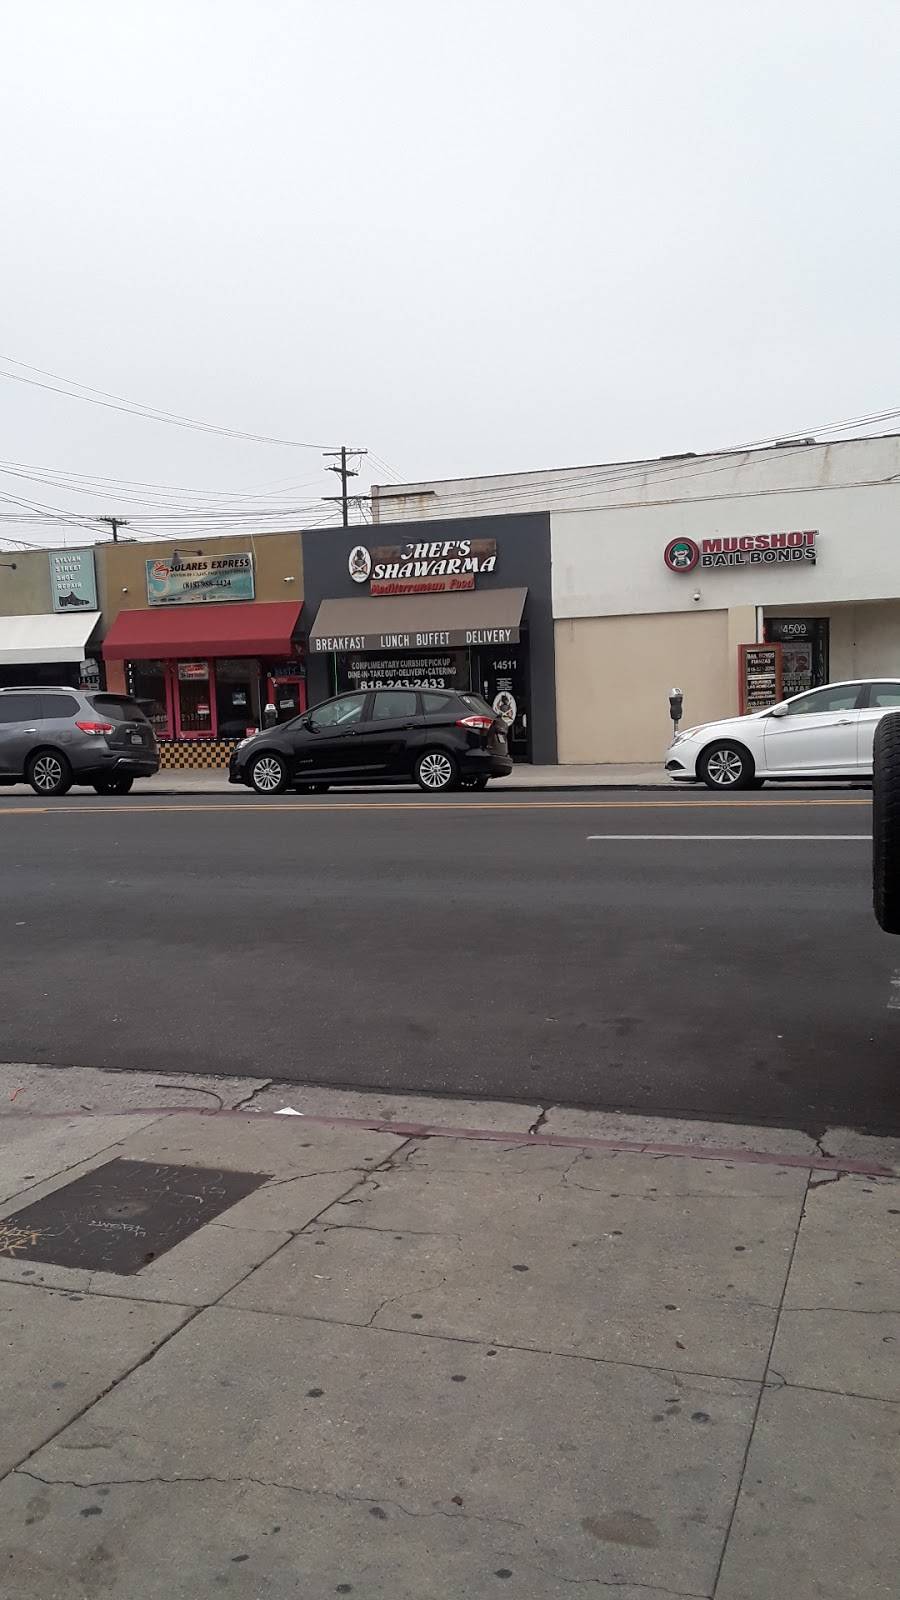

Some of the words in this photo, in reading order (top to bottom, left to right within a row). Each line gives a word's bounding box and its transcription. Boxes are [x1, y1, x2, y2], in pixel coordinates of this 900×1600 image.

[702, 530, 817, 553] MUGSHOT
[701, 552, 746, 567] BAIL
[750, 548, 816, 563] BONDS
[170, 562, 208, 572] SOLARES
[211, 559, 249, 569] EXPRESS
[372, 556, 496, 580] SHAWARMA
[371, 582, 445, 595] Mediterranean
[316, 636, 365, 651] BREAKFAST
[380, 634, 410, 648] LUNCH
[416, 632, 450, 646] BUFFET
[466, 629, 511, 643] DELIVERY
[352, 660, 400, 670] COMPLIMENTARY
[400, 659, 428, 668] CURBSIDE
[428, 658, 442, 666] PICK
[442, 658, 450, 666] UP
[493, 660, 517, 670] 14511
[360, 678, 445, 690] 818-243-2433
